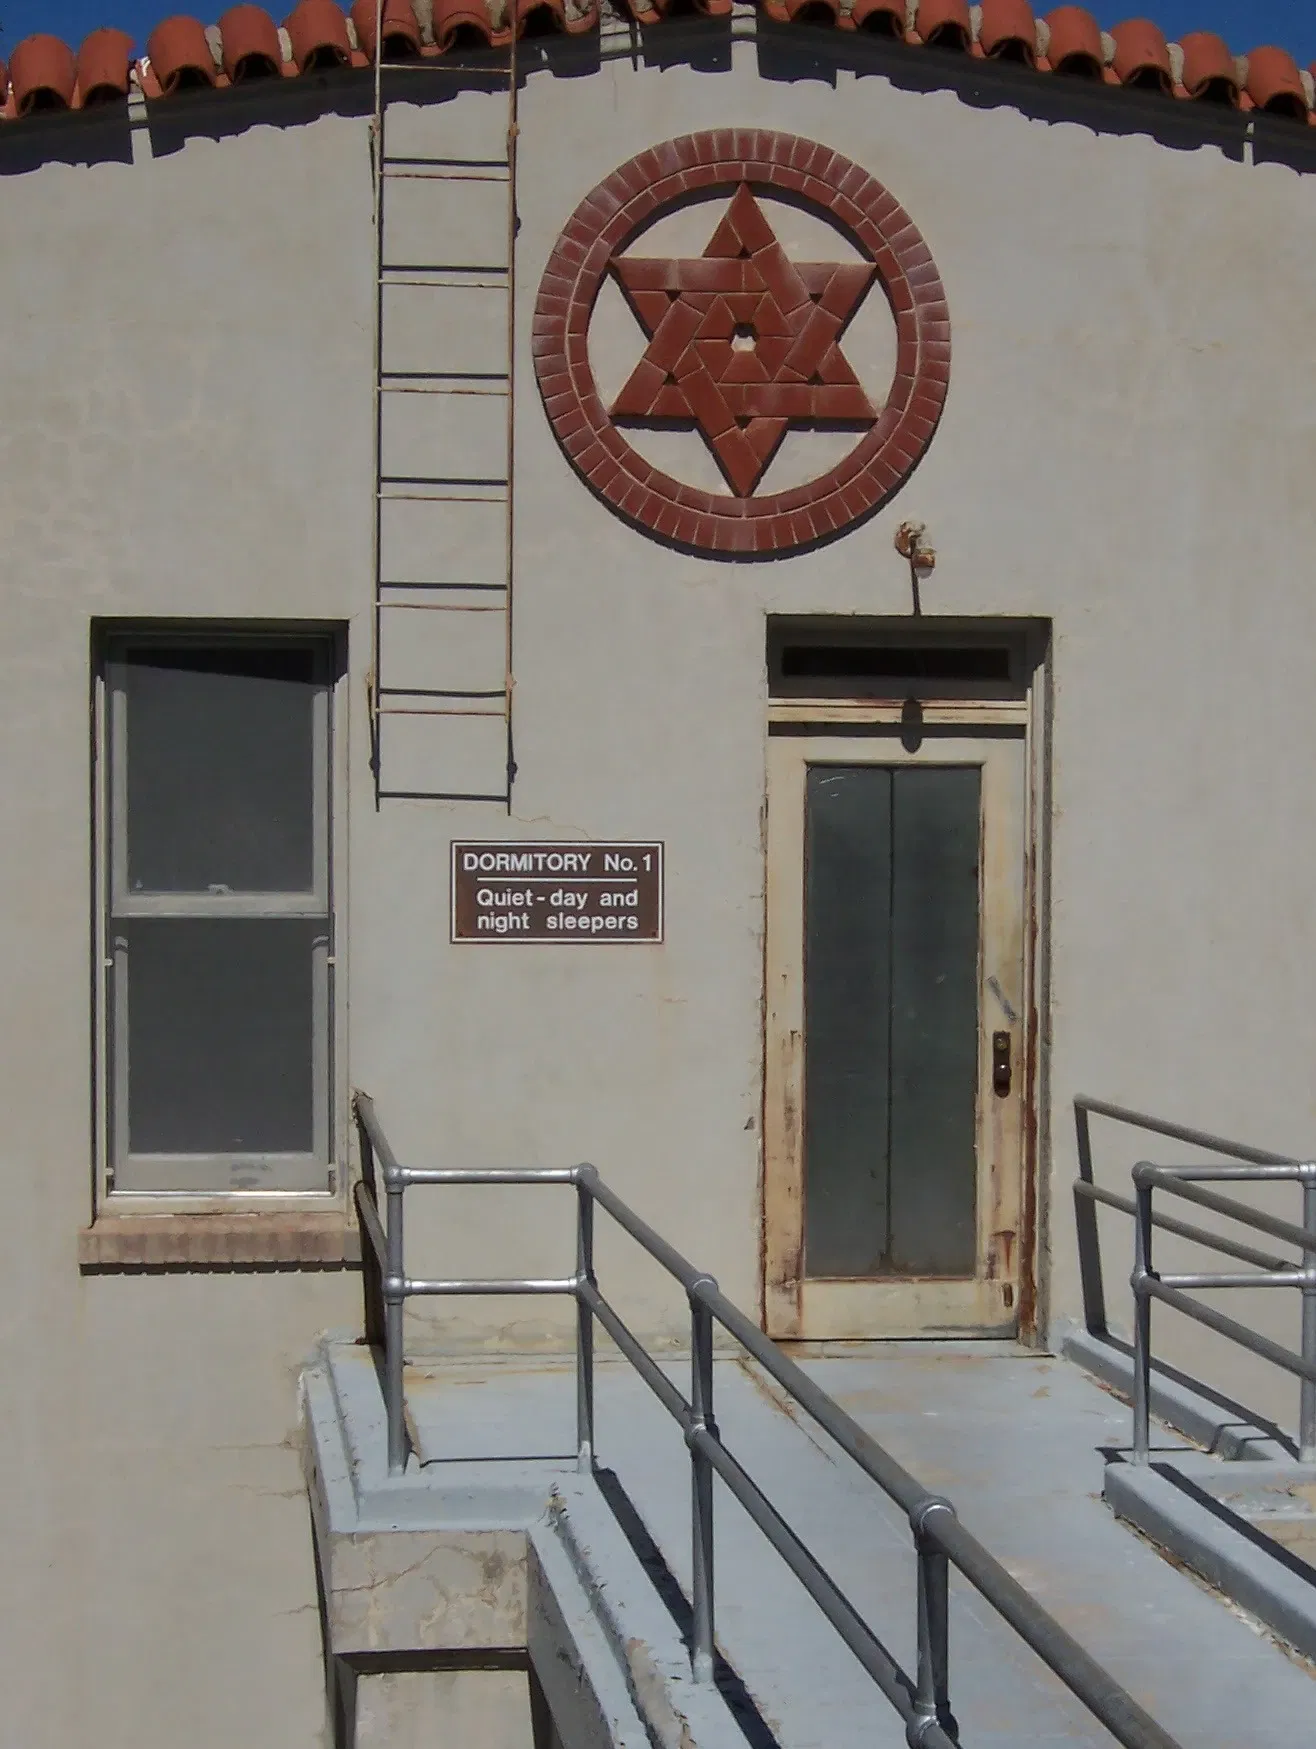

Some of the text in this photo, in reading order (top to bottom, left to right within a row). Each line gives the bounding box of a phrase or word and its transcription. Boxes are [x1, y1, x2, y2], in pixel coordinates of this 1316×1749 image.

[463, 853, 651, 871] DORMITORY No. 1
[599, 889, 639, 906] and
[477, 912, 639, 933] night sleepers
